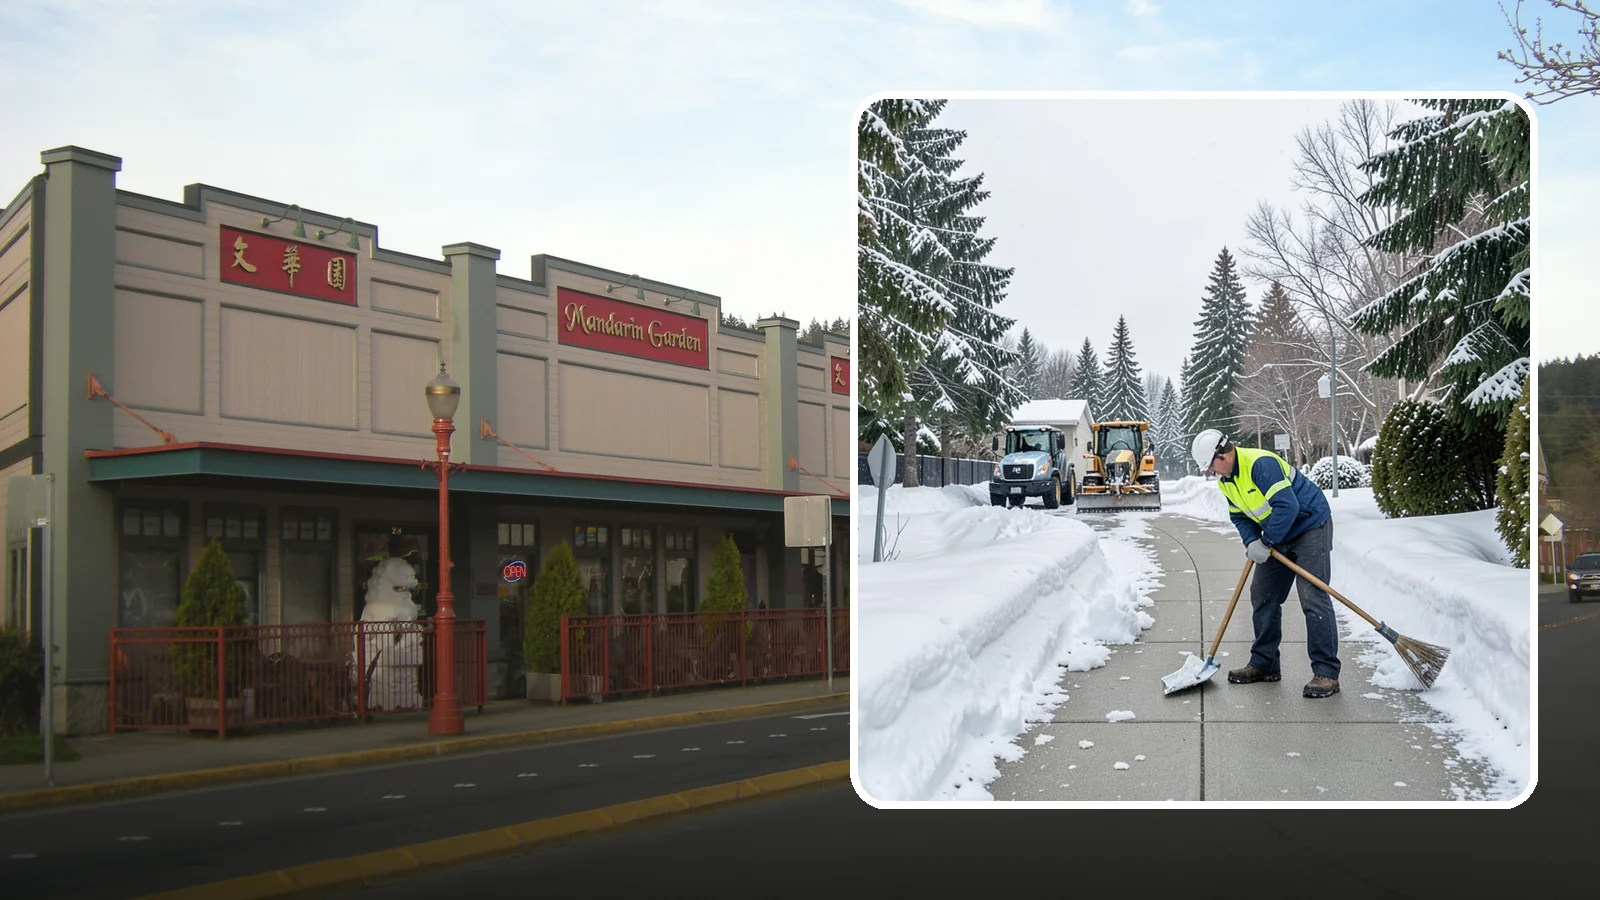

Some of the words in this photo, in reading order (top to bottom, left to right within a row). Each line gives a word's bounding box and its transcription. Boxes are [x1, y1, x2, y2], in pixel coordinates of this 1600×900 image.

[231, 236, 346, 291] 文華園
[564, 302, 644, 341] Mandarin
[648, 320, 702, 352] Garden
[503, 565, 527, 578] OPEN
